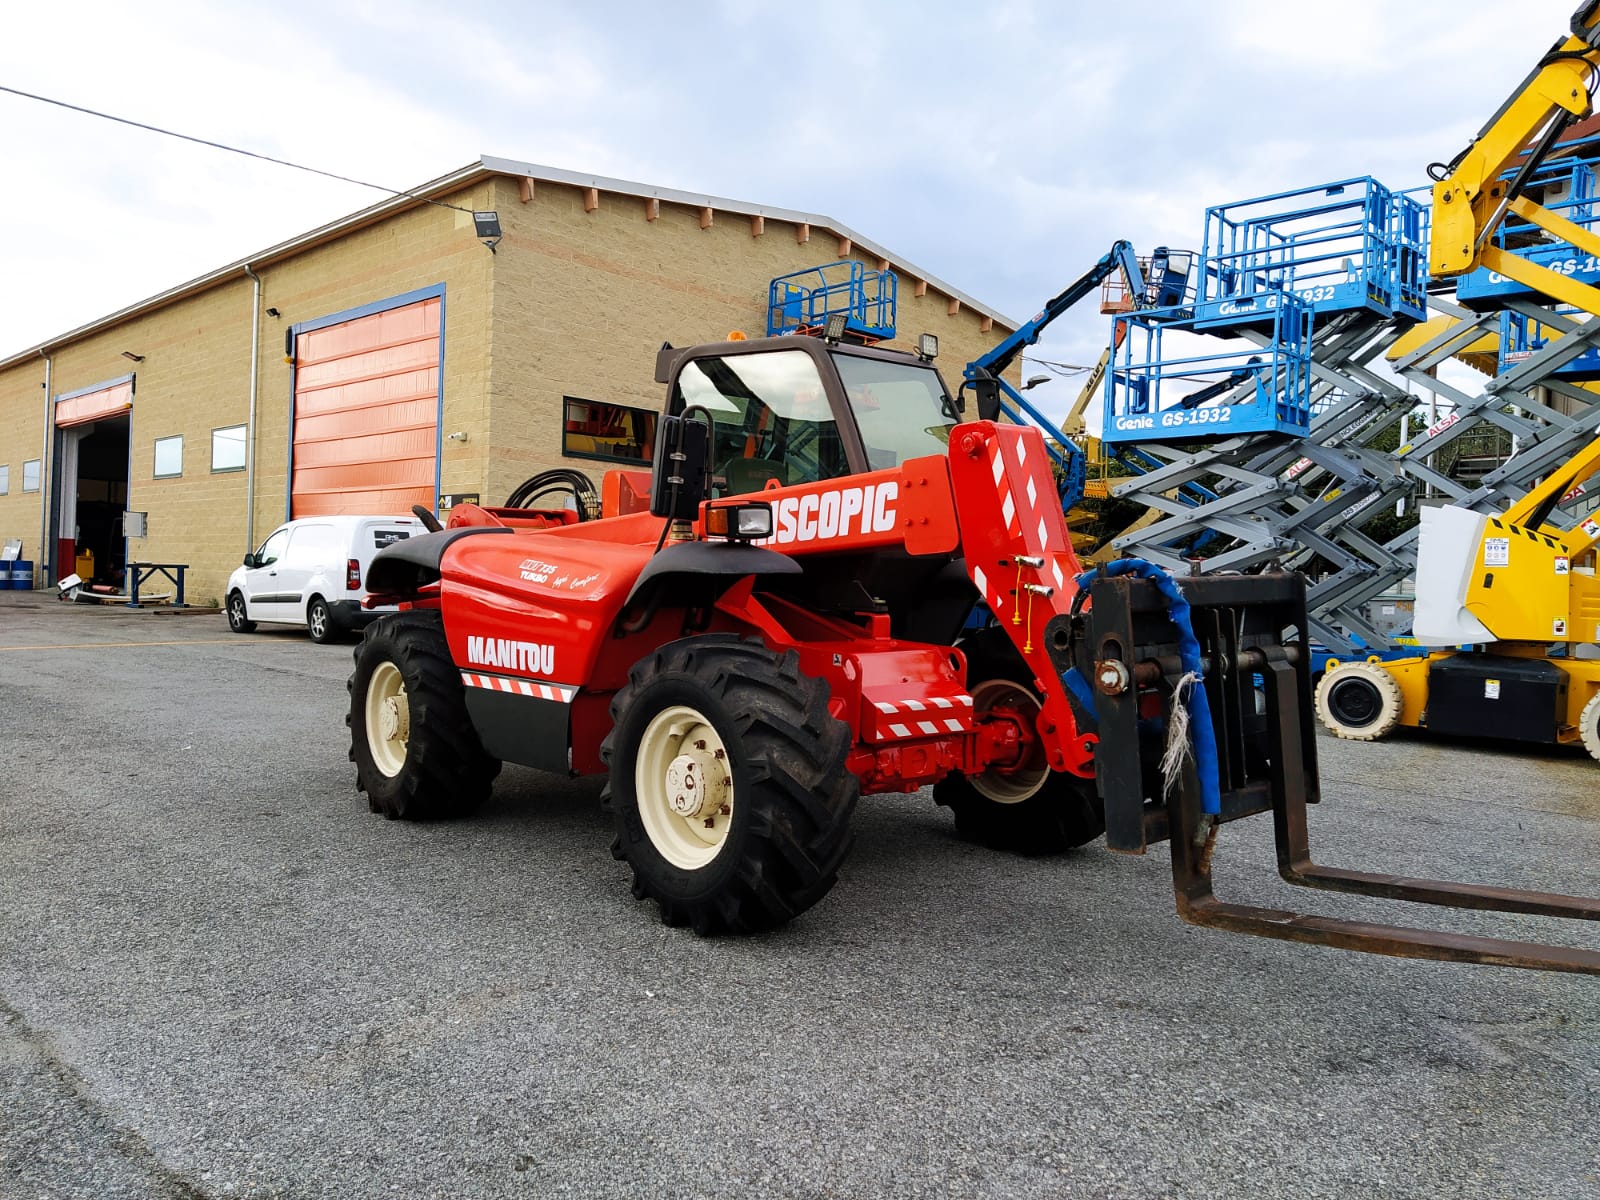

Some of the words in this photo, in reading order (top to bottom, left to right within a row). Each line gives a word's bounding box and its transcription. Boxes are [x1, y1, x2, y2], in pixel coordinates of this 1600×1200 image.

[1547, 256, 1600, 276] GS-1
[1265, 285, 1335, 309] G932
[1116, 416, 1154, 431] Genie
[1162, 407, 1231, 427] GS-1932
[1429, 414, 1459, 438] ALSA
[1288, 456, 1313, 479] ALS
[1560, 486, 1585, 505] SA
[520, 570, 548, 584] TURBO
[467, 635, 555, 675] MANITOU
